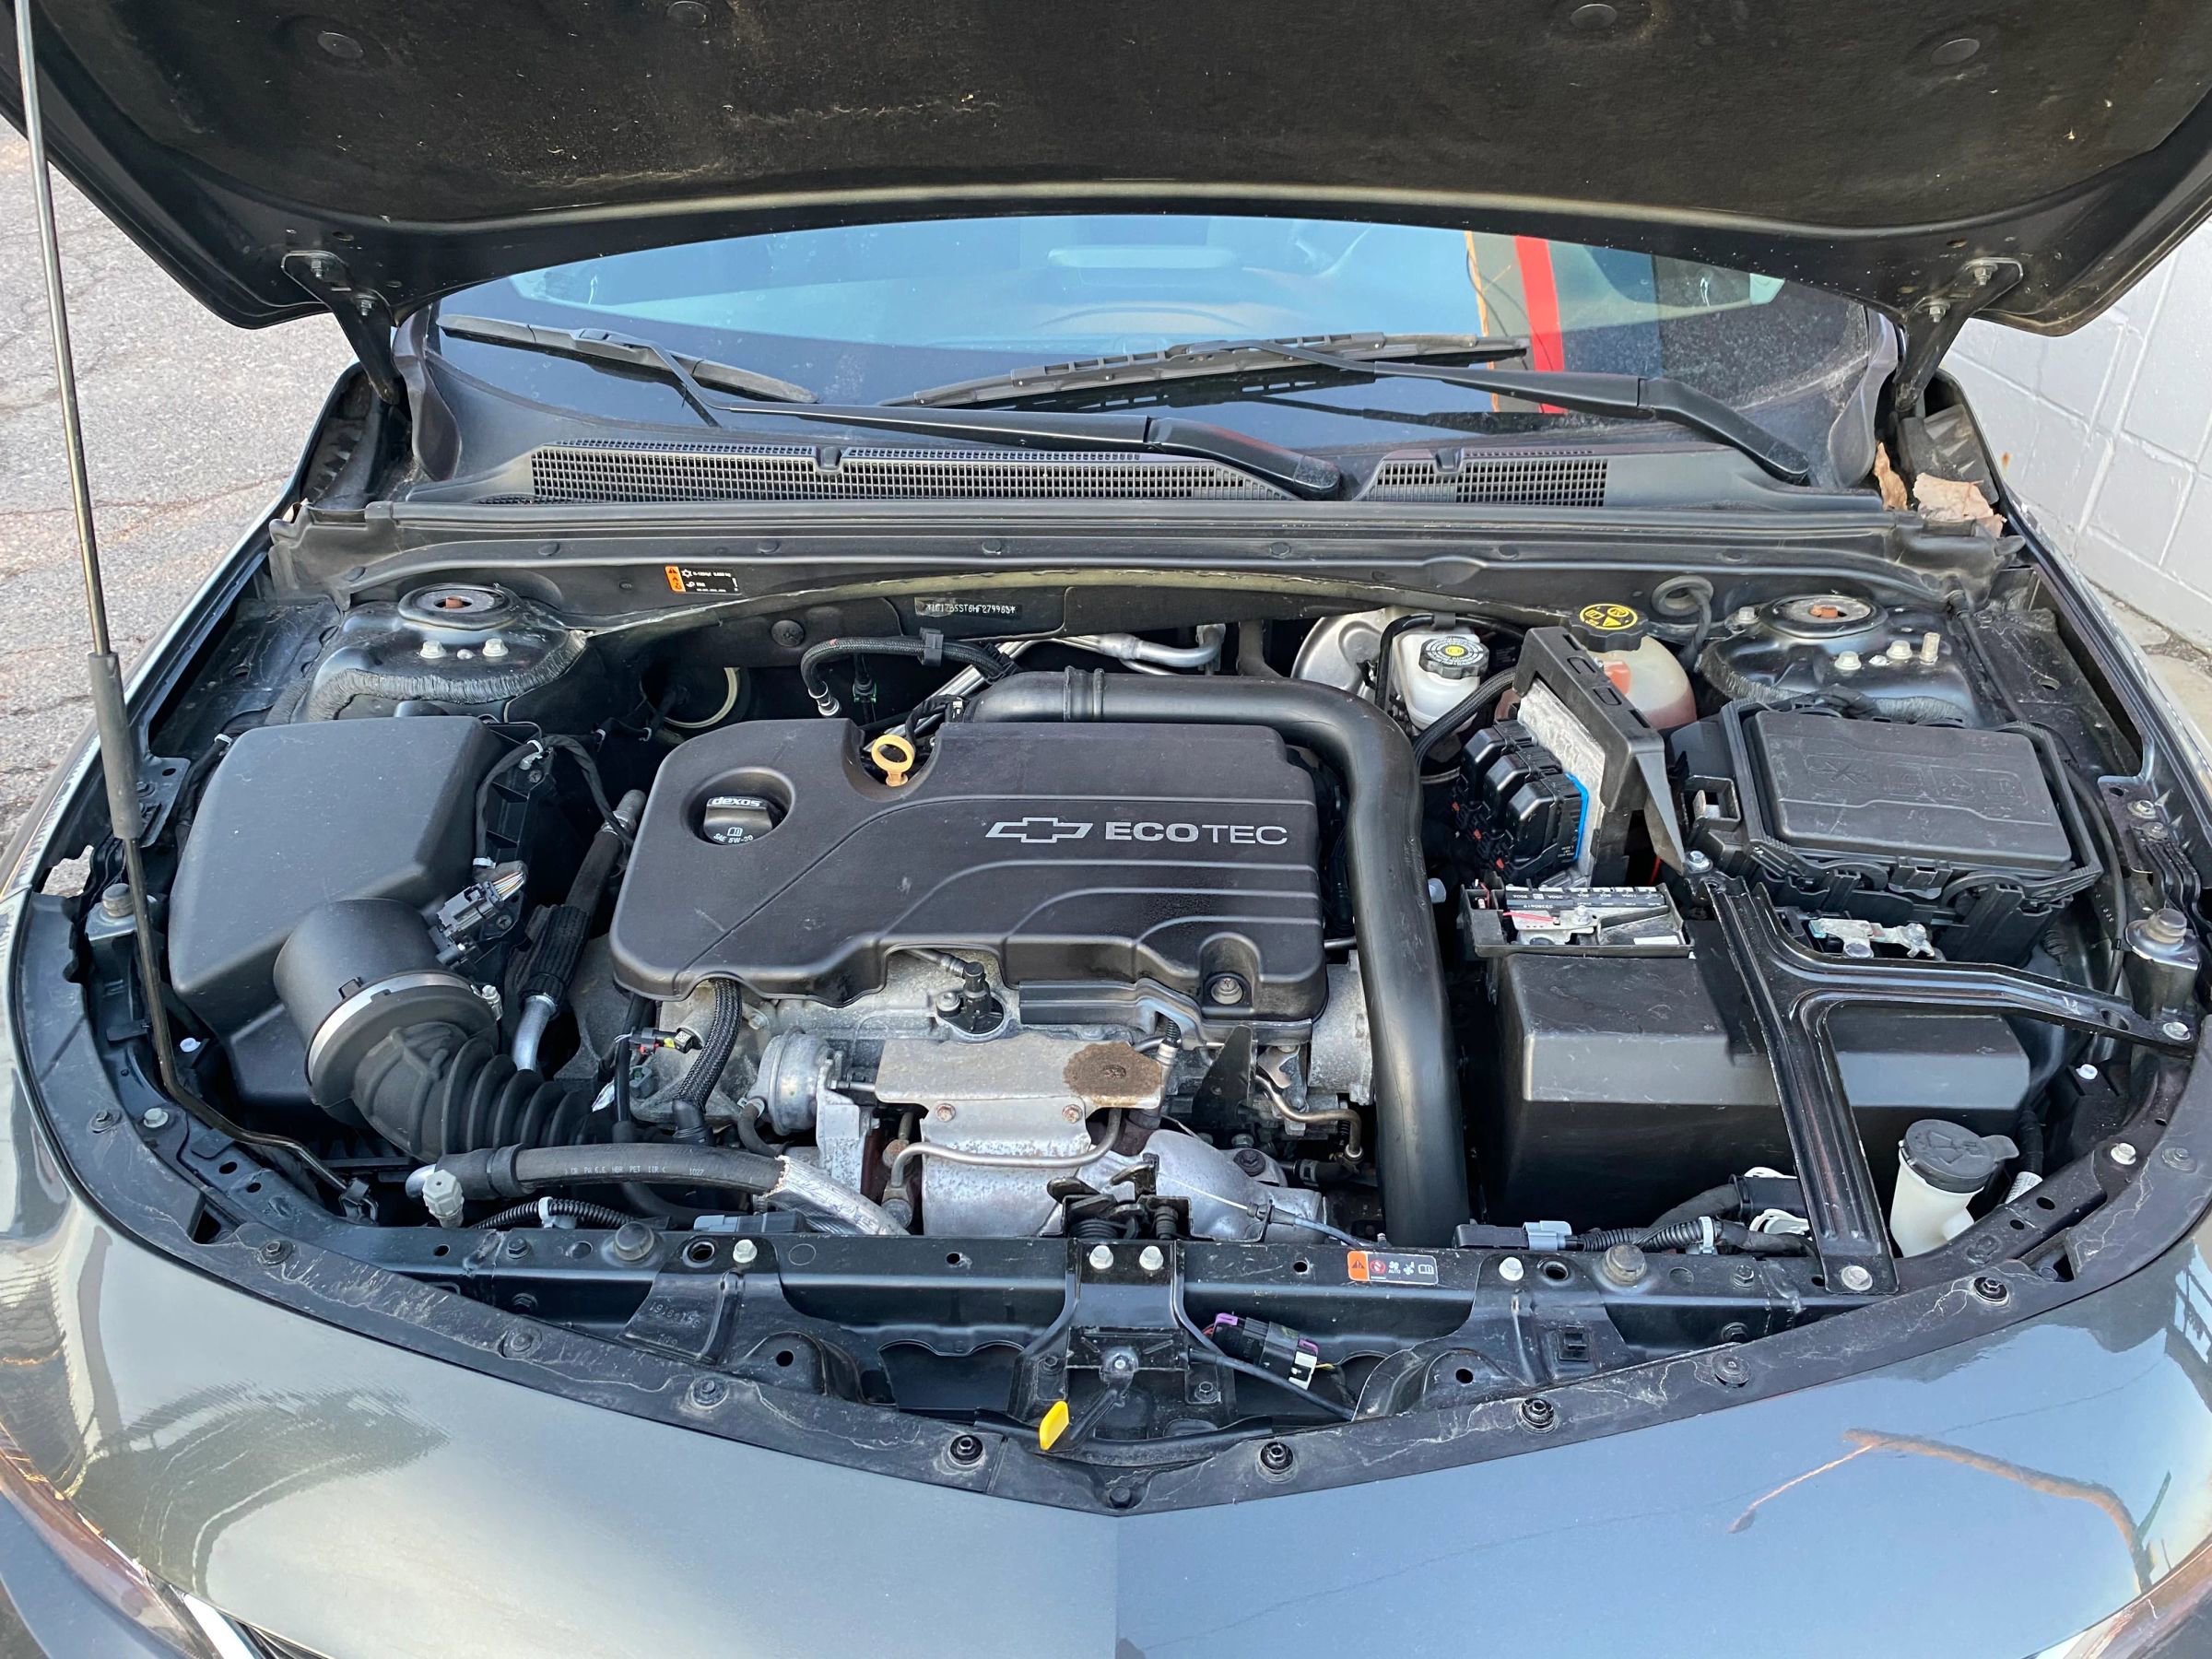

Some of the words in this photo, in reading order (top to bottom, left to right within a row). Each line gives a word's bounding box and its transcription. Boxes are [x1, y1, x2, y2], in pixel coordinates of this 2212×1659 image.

[712, 796, 761, 807] dexos
[713, 833, 727, 842] SAE
[728, 835, 754, 843] 5W-30
[1105, 821, 1288, 845] ECOTEC
